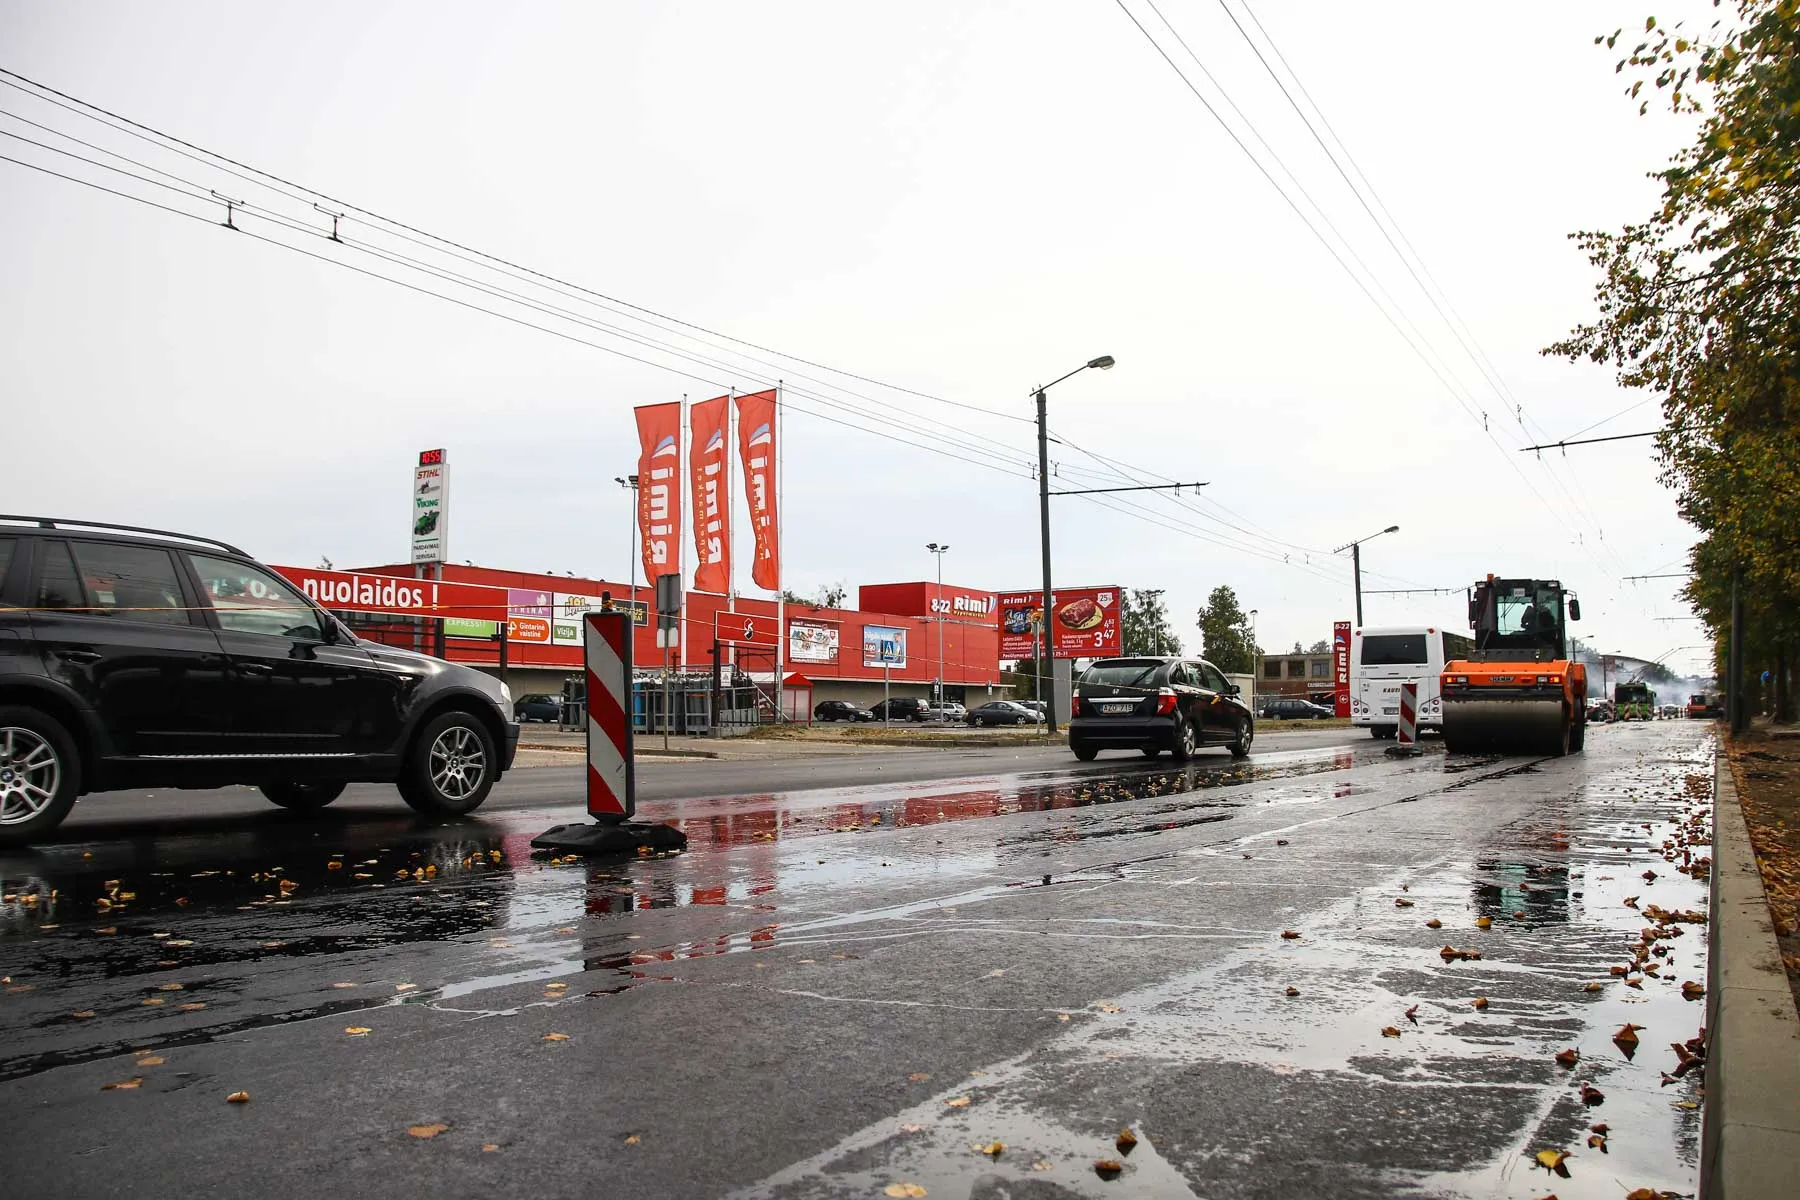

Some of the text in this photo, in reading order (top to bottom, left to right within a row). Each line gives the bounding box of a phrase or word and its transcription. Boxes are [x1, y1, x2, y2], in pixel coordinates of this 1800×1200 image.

[417, 469, 440, 479] STIHL
[416, 498, 439, 508] VIKING
[303, 576, 423, 608] nuolaidos
[954, 595, 987, 613] Rimi
